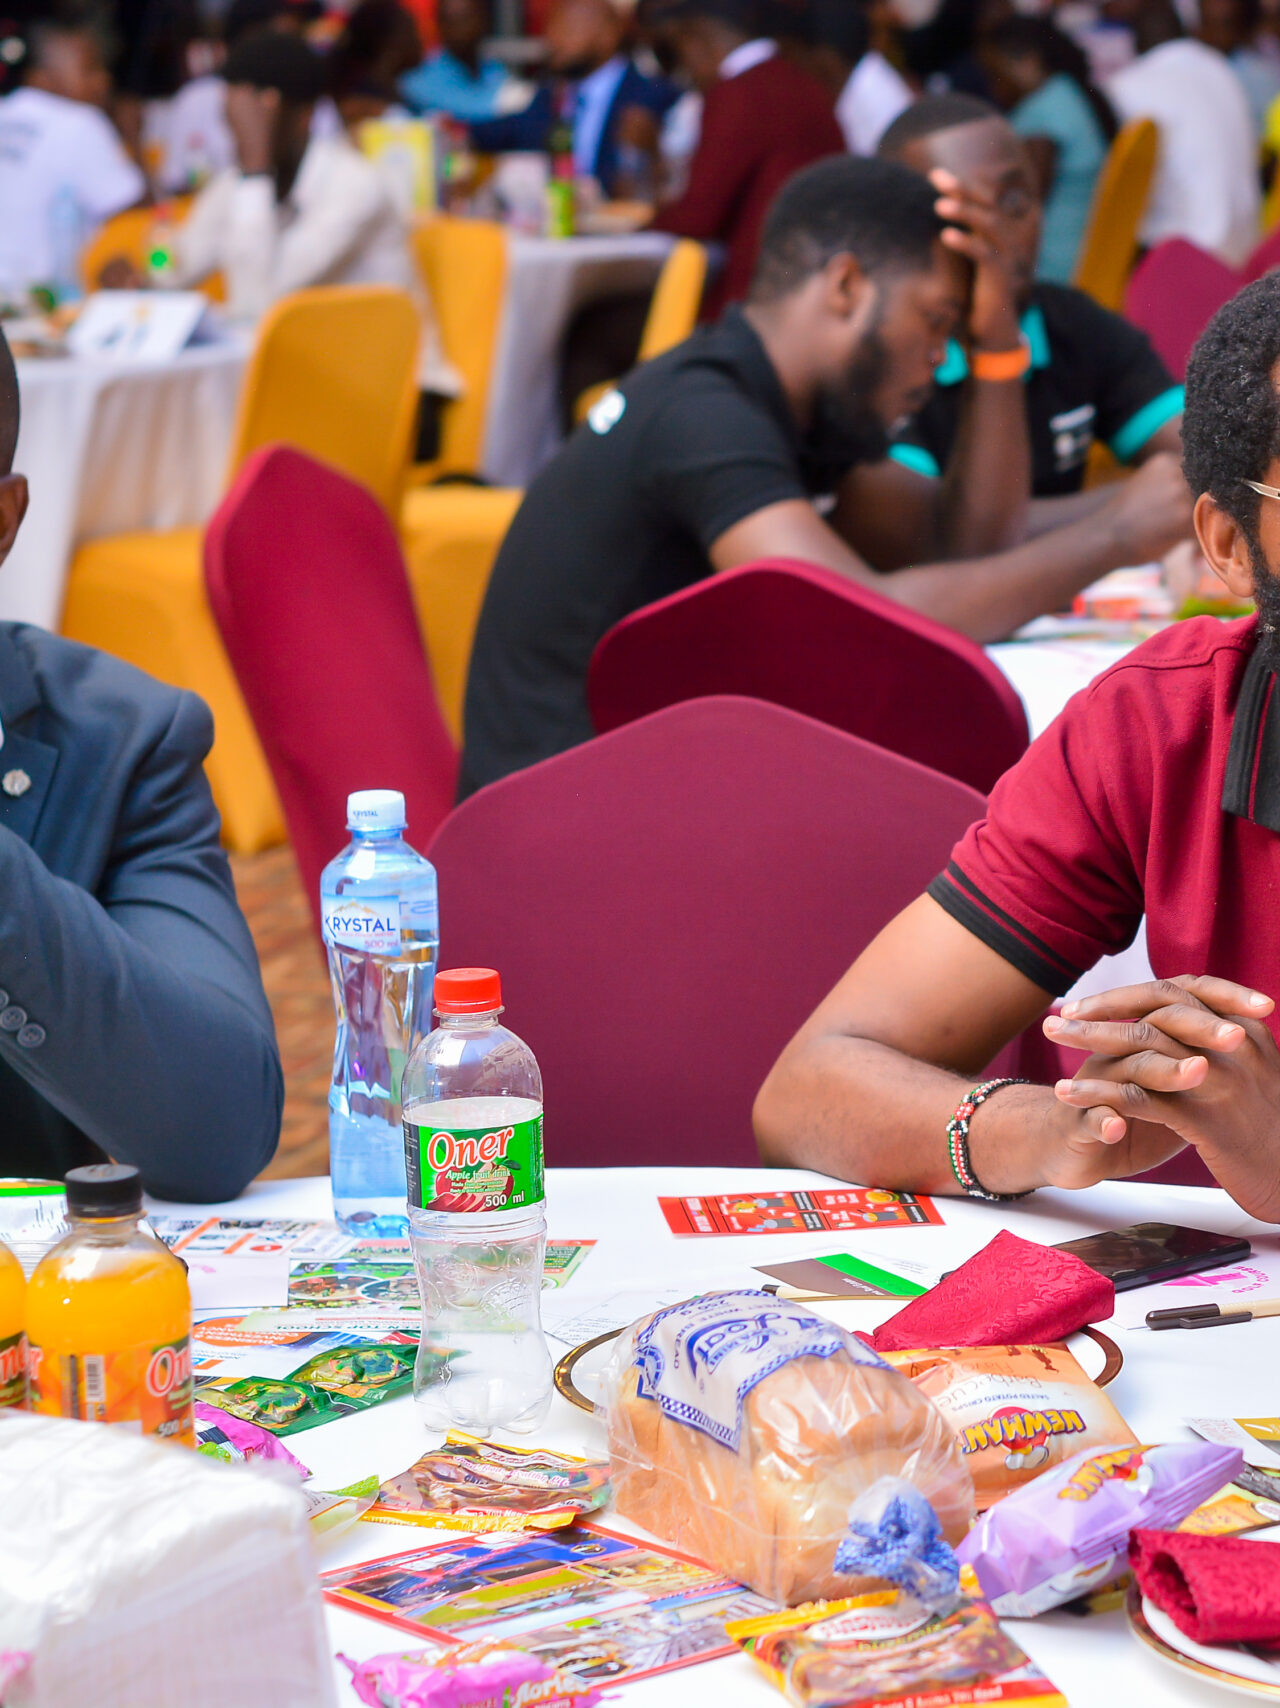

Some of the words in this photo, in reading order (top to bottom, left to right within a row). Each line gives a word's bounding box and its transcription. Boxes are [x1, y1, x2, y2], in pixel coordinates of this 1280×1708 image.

[427, 1126, 515, 1173] Oner
[445, 1170, 471, 1180] Apple
[485, 1193, 508, 1208] 500
[512, 1190, 525, 1204] ml
[0, 1335, 44, 1385] ner
[957, 1408, 1088, 1454] NEWMAN'
